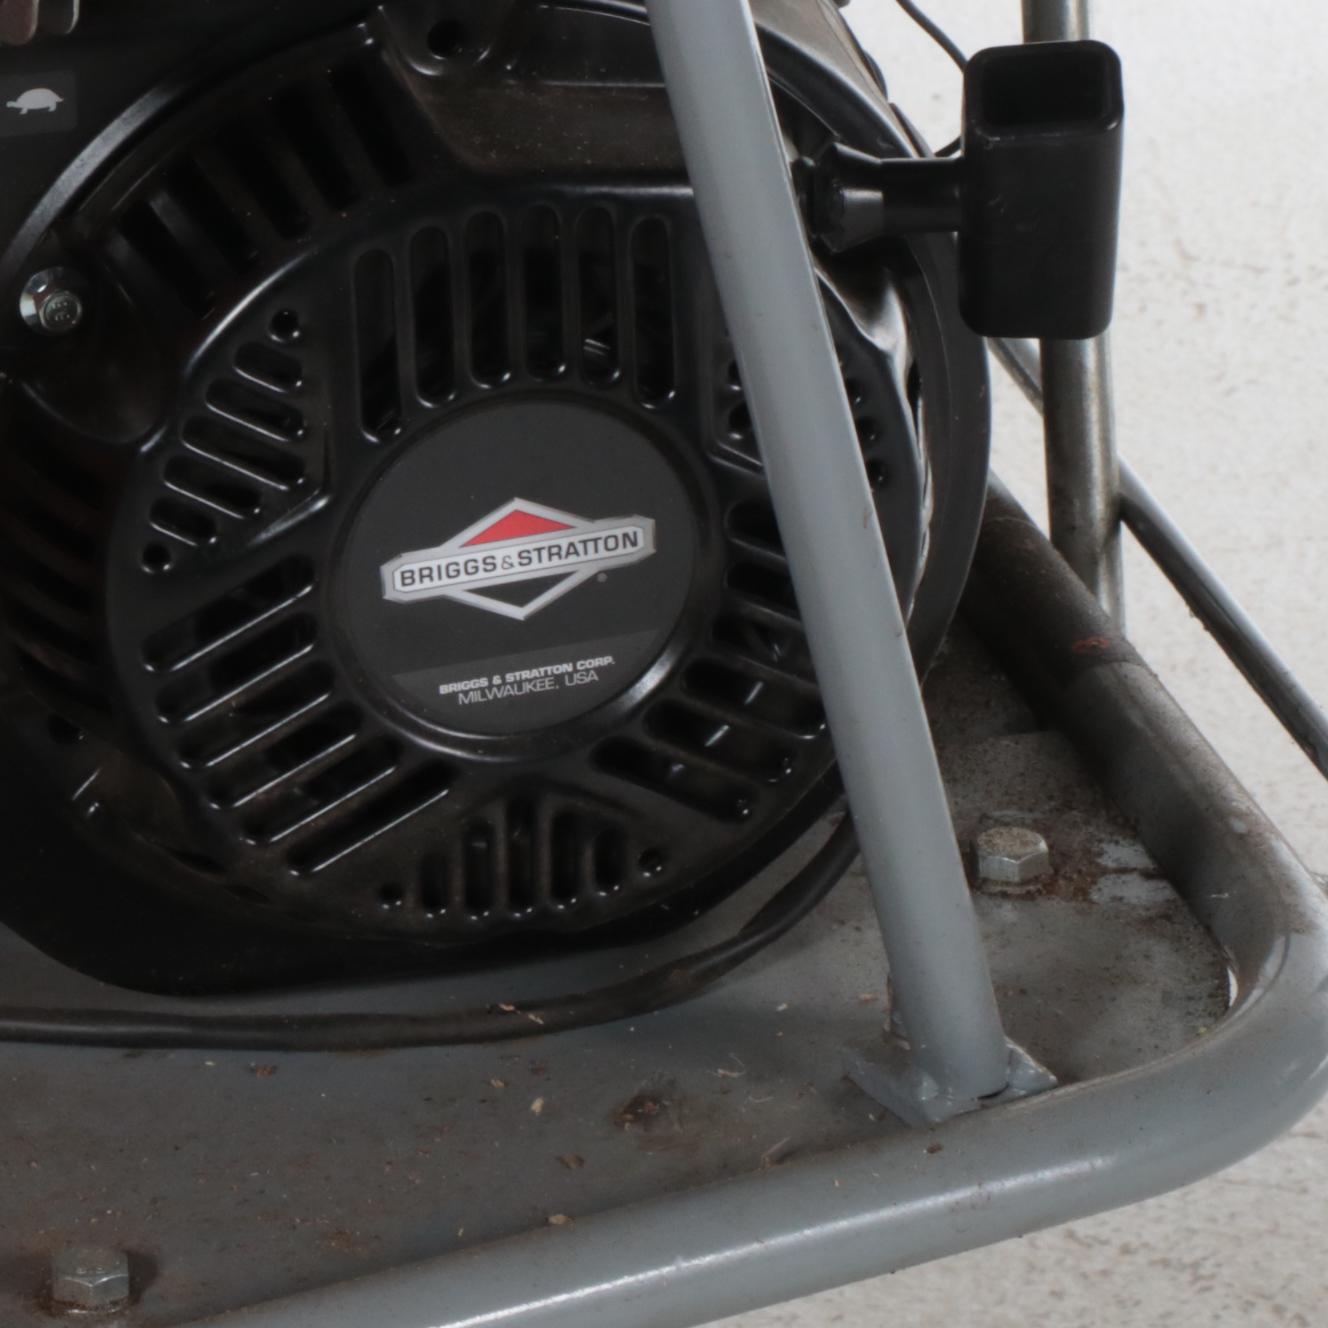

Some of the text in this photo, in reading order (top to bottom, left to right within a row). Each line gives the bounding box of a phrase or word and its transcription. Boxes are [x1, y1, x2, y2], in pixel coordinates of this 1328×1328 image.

[439, 656, 616, 695] BRIGGS & STRATTON CORP.
[564, 669, 599, 687] USA
